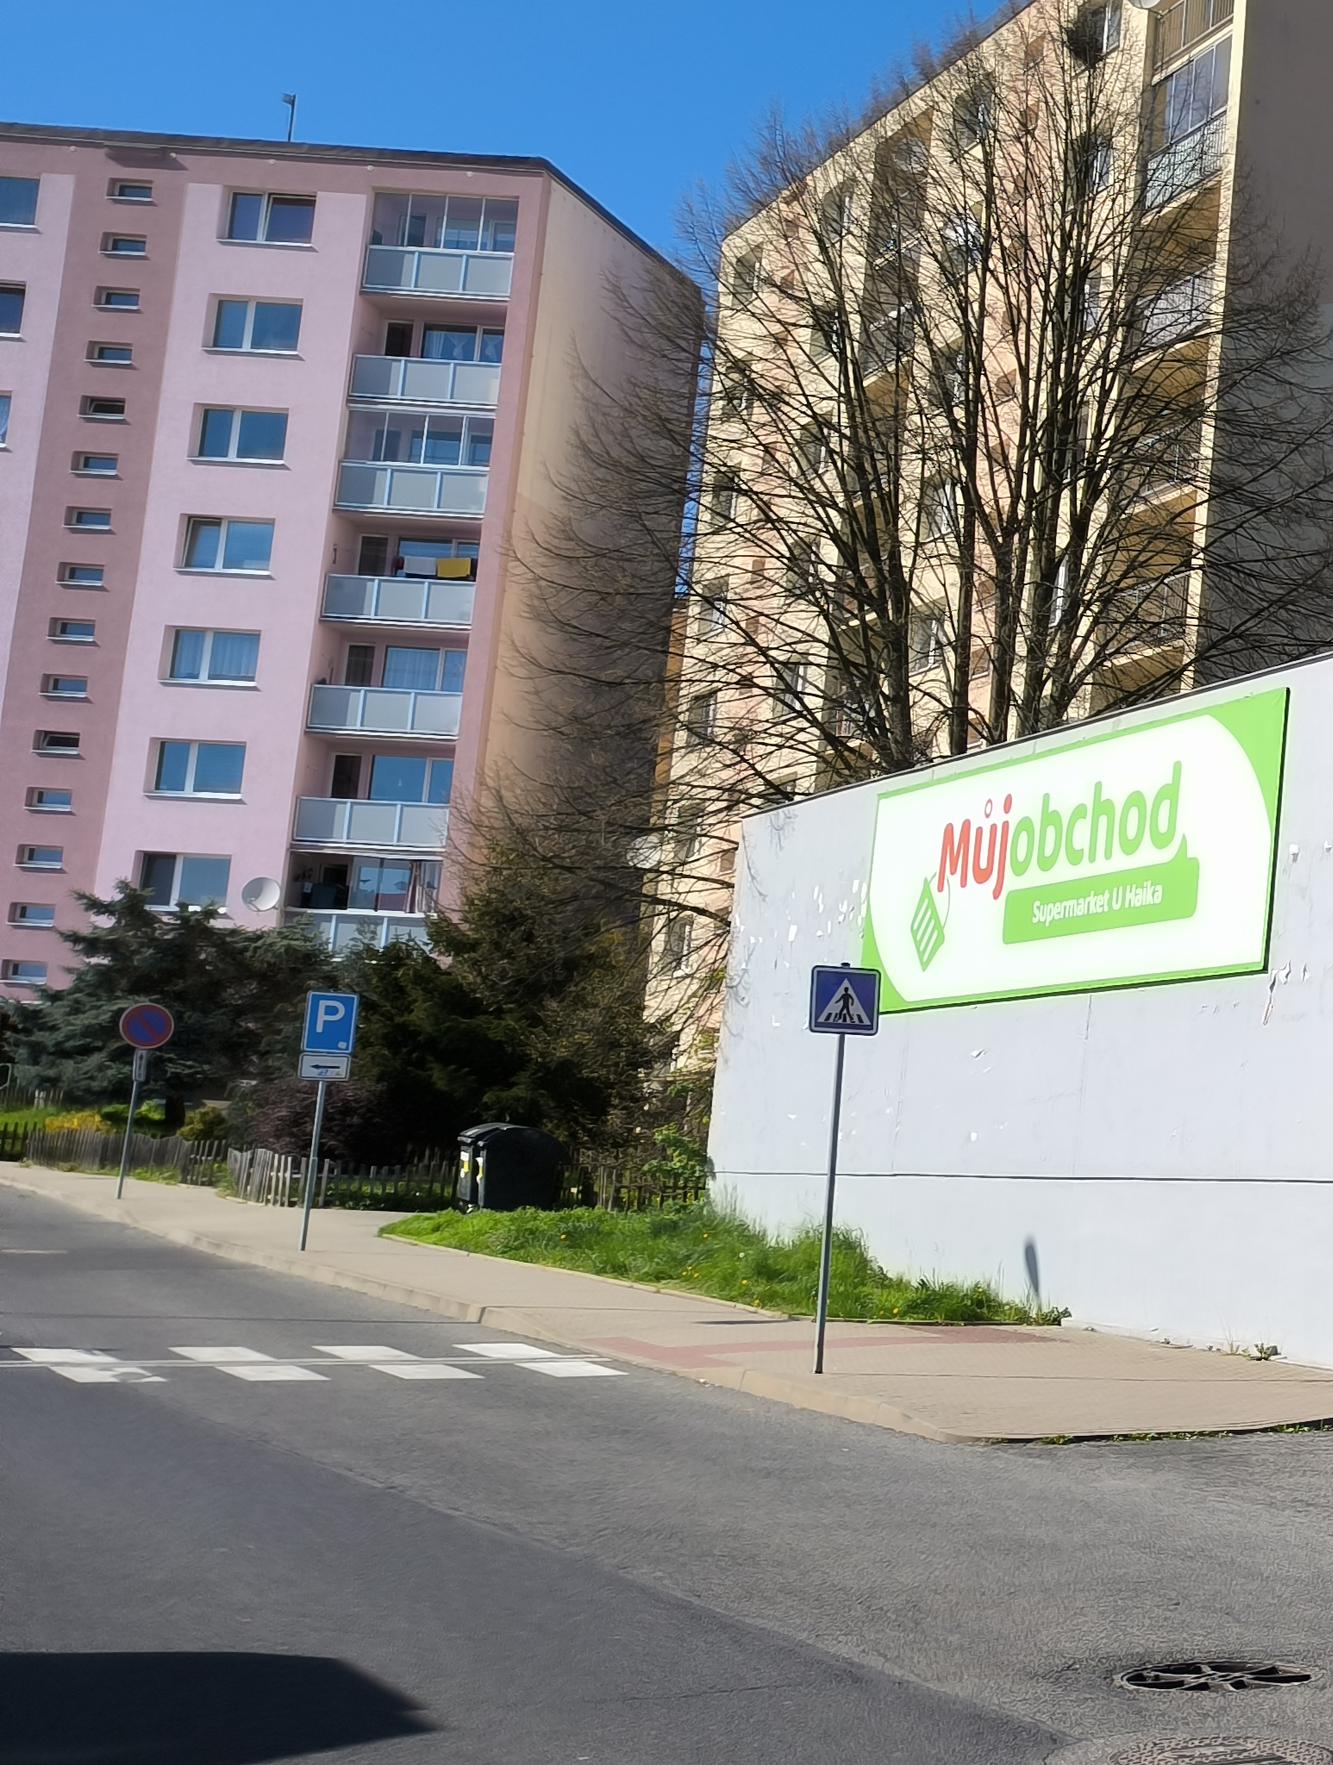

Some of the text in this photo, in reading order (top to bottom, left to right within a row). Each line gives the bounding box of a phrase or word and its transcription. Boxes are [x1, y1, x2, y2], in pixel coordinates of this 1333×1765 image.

[1032, 890, 1109, 927] Supermarket
[1112, 890, 1123, 911] U
[316, 1000, 345, 1033] P
